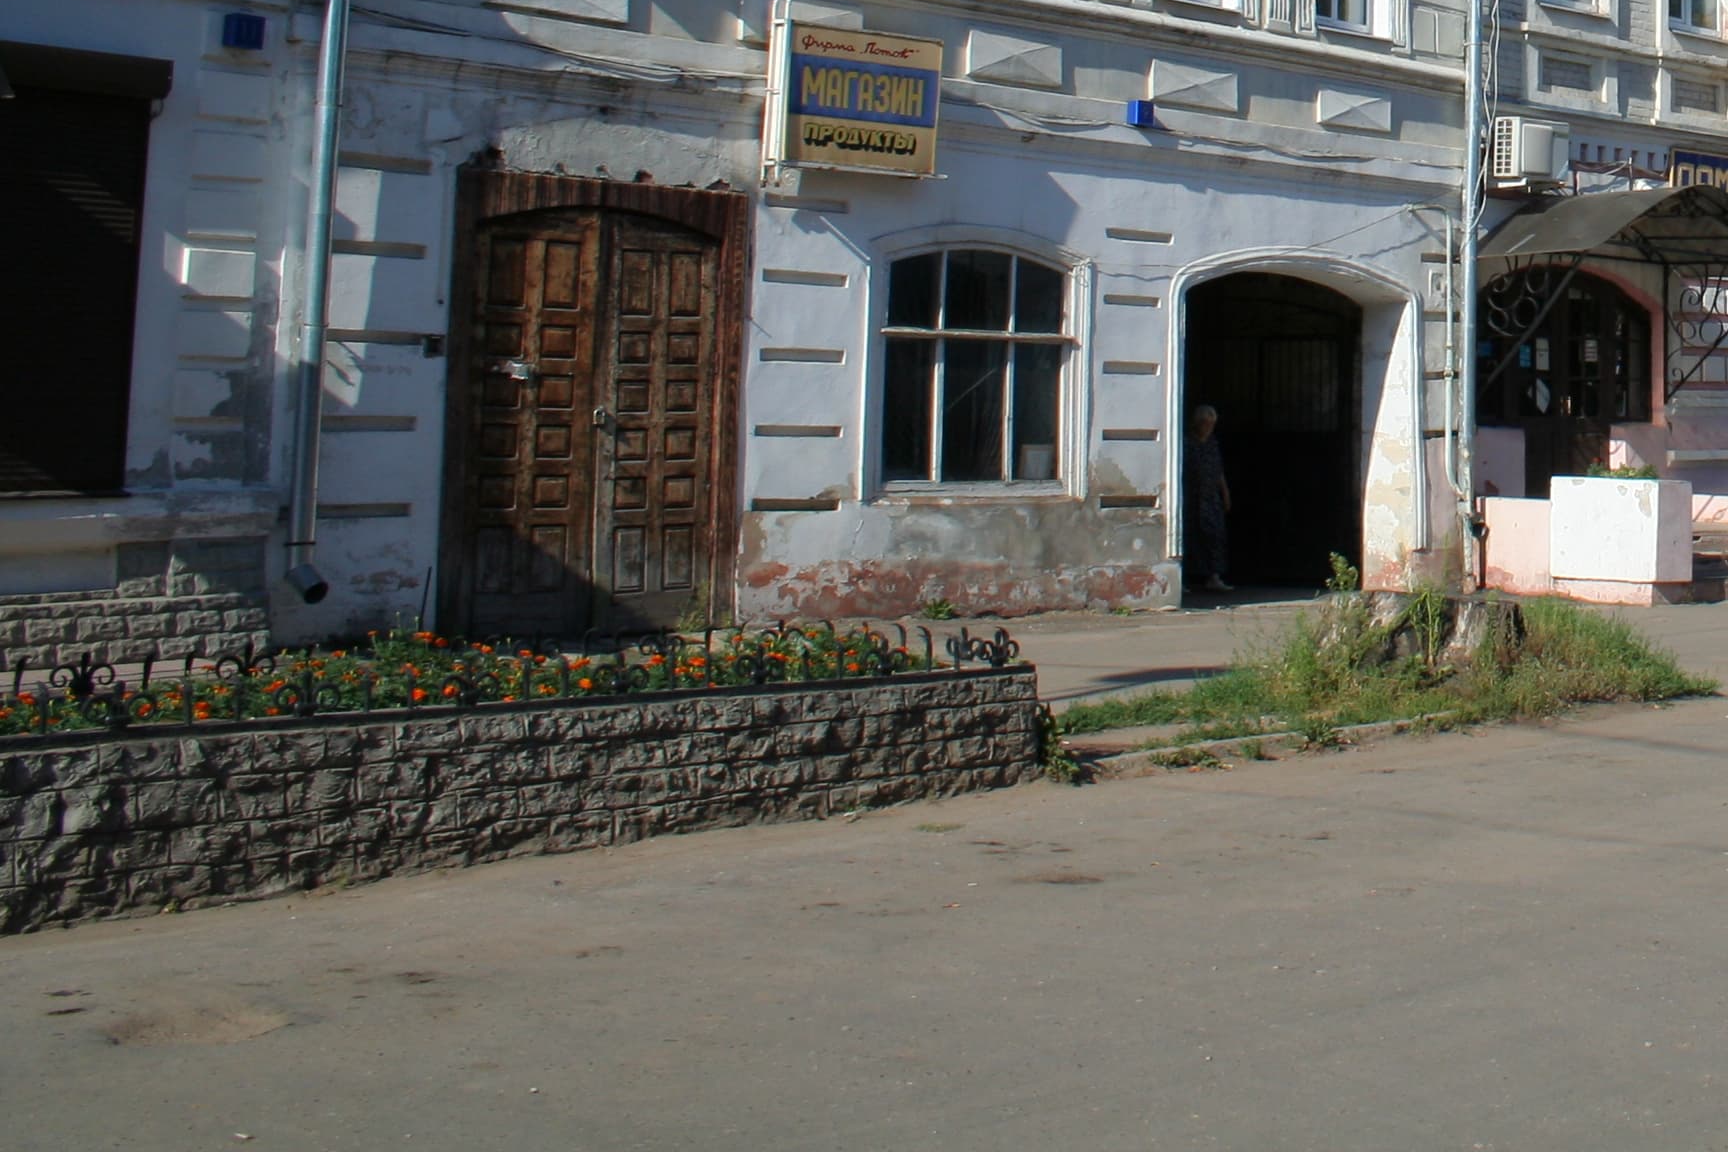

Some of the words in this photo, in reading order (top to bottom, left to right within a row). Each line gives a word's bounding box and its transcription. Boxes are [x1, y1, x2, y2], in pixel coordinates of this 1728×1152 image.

[802, 35, 855, 52] Фирма
[802, 66, 924, 117] МАГАЗИН
[804, 123, 917, 155] ПРОДУКТЫ
